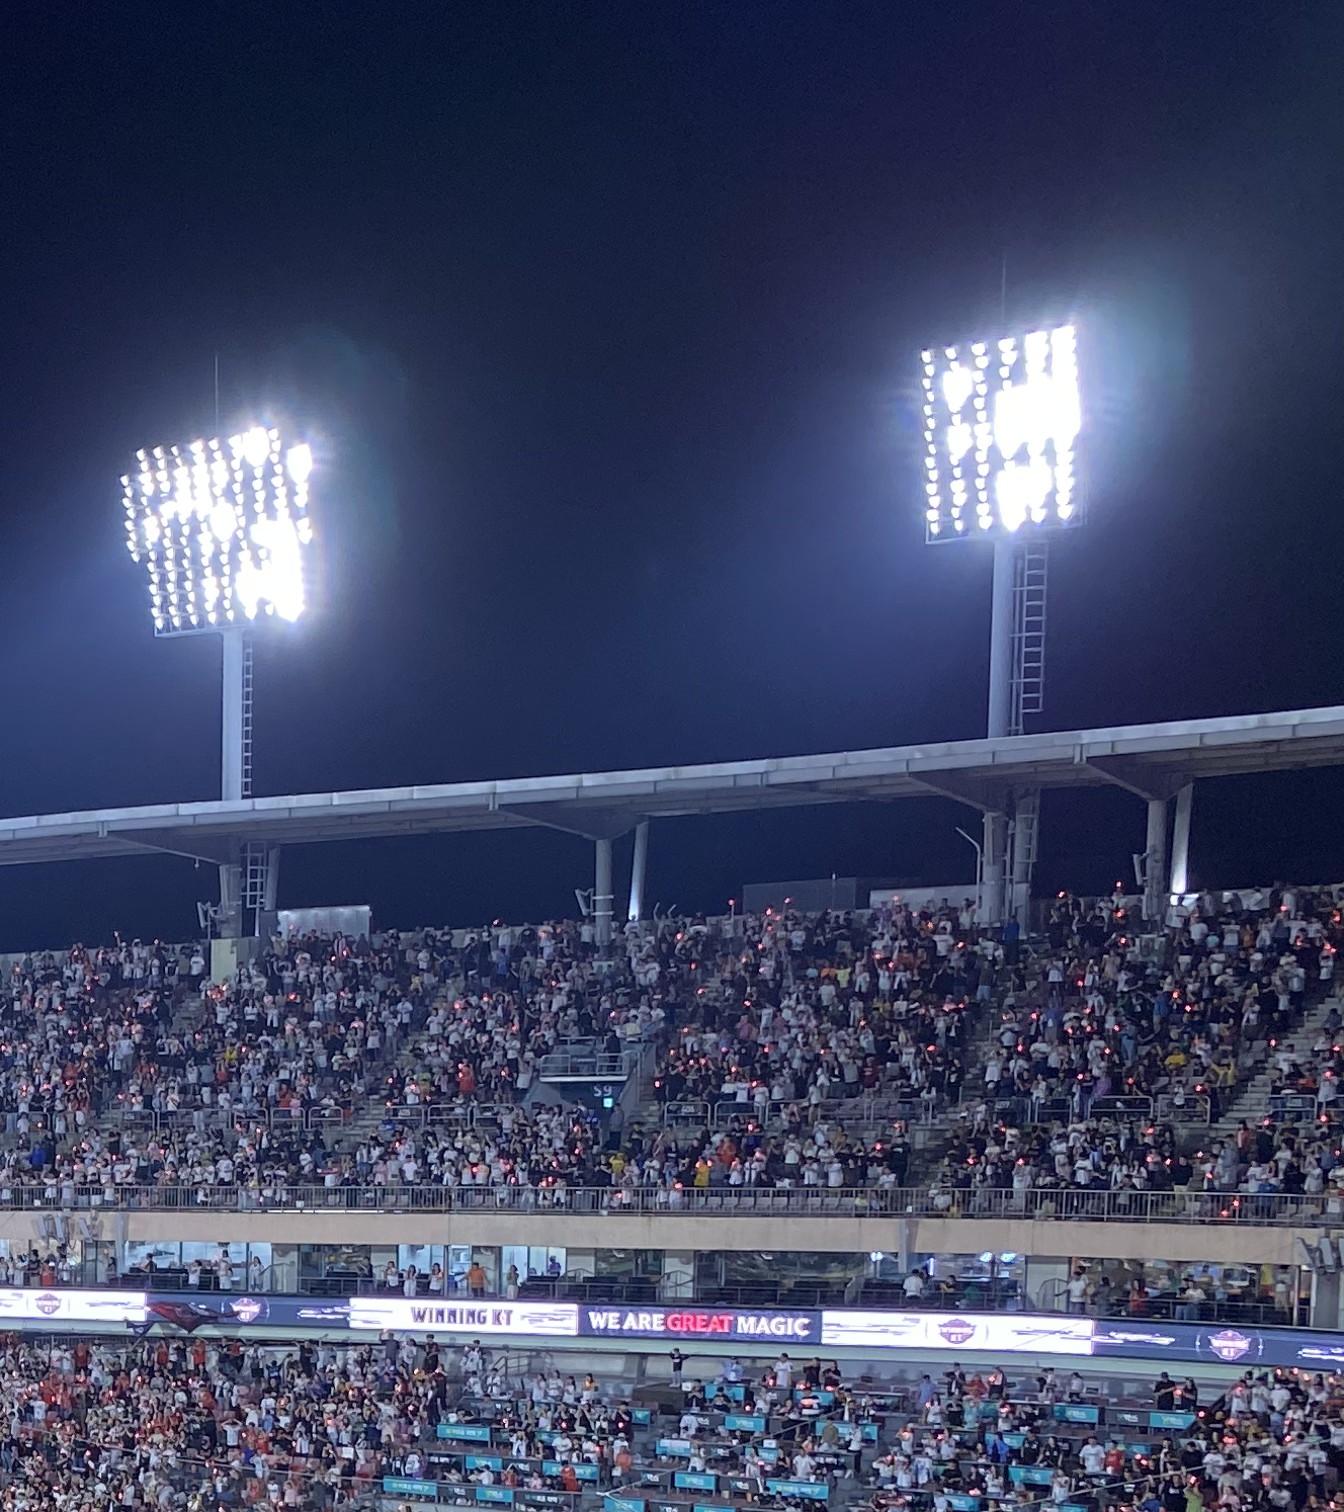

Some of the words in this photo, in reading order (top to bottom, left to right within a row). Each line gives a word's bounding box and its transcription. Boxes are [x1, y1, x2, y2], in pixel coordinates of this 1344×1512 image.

[411, 1305, 489, 1325] WINNING
[493, 1306, 513, 1327] KT
[589, 1310, 621, 1330] WE
[624, 1312, 665, 1333] ARE
[667, 1313, 733, 1334] GREAT
[736, 1315, 810, 1336] MAGIC
